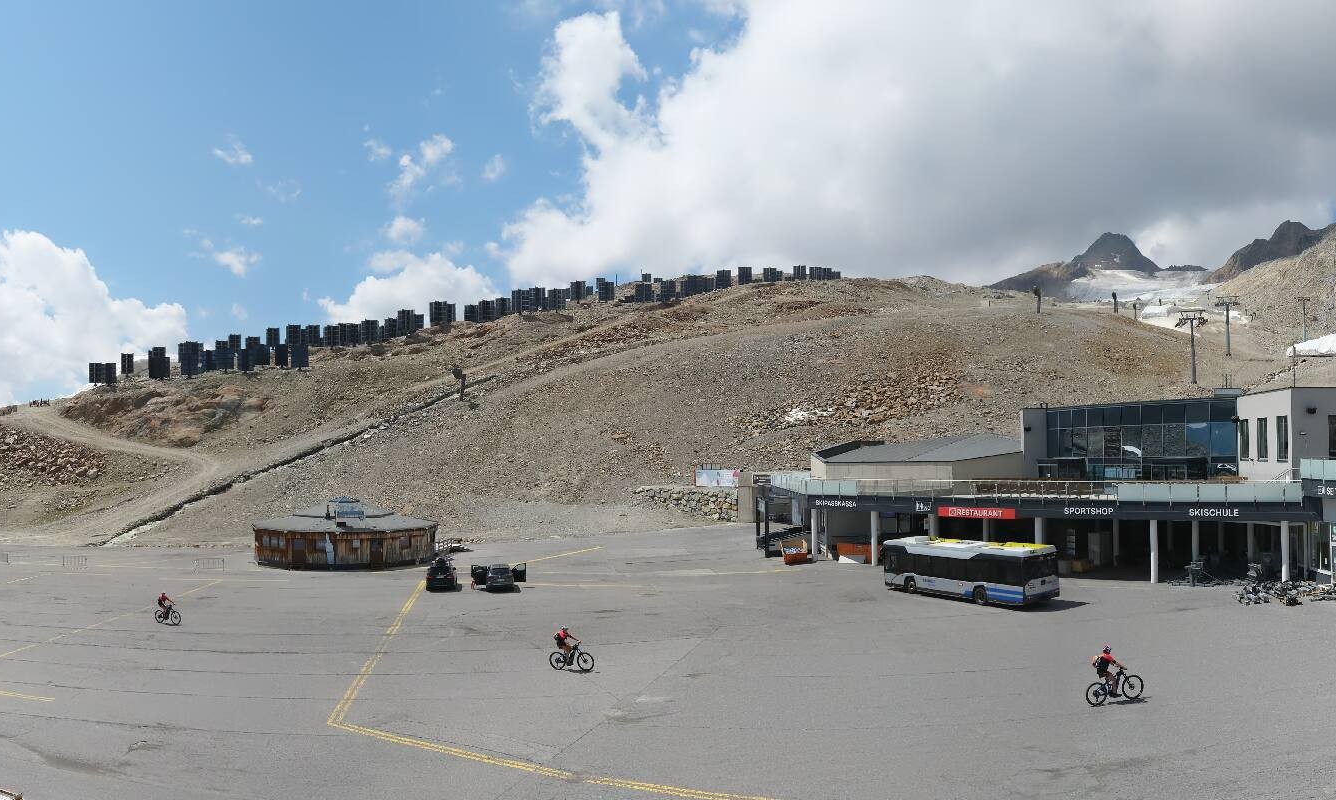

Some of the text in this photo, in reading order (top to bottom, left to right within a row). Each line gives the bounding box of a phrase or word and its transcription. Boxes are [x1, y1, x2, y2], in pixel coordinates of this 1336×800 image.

[956, 508, 1003, 517] RESTAURANT
[1064, 507, 1114, 516] SPORTSHOP
[1189, 508, 1240, 517] SKISCHULE
